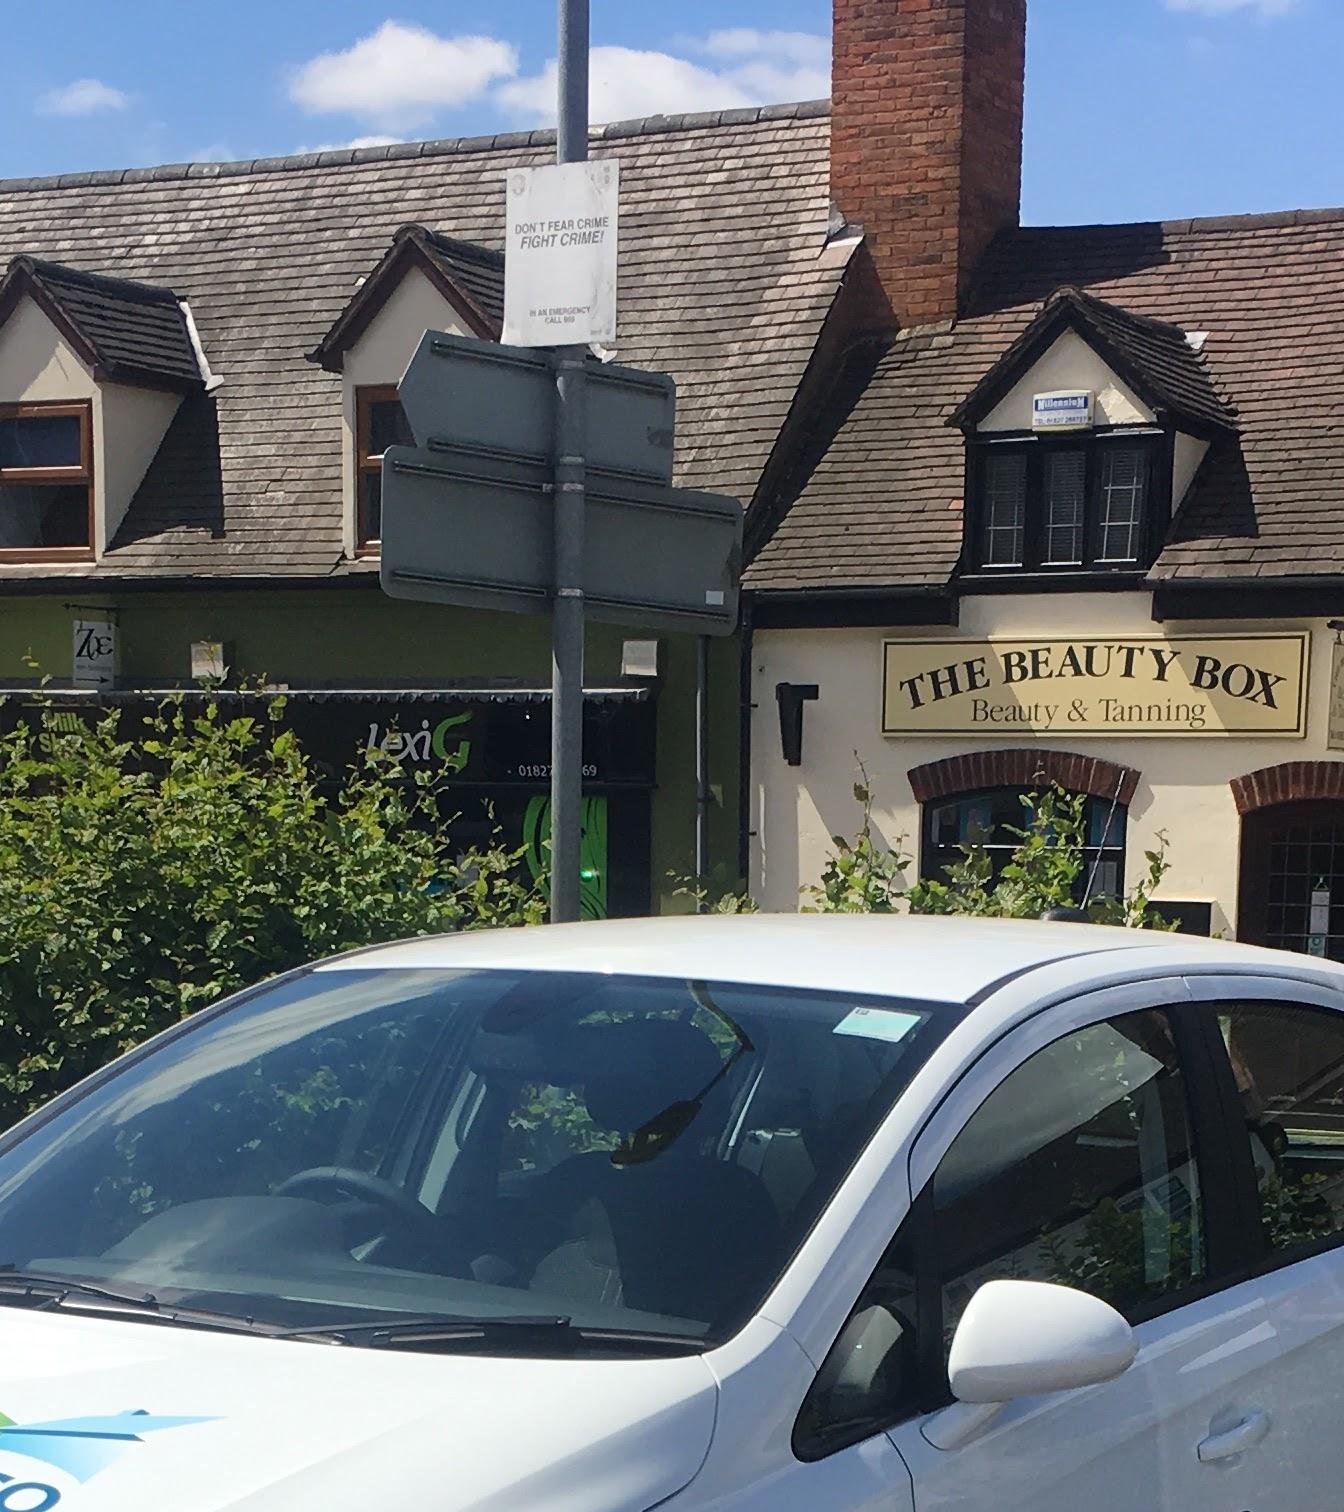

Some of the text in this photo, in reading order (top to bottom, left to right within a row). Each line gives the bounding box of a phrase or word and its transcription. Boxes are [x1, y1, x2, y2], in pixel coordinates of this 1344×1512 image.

[548, 219, 574, 232] FEAR
[576, 216, 609, 230] CRIME
[520, 230, 605, 249] FIGHT CRIME!
[548, 306, 590, 316] EMERGENCY
[544, 315, 562, 325] CALL
[899, 657, 991, 710] THE
[1000, 645, 1182, 685] BEAUTY
[1189, 655, 1287, 709] BOX
[970, 698, 1207, 729] Beauty & Tanning
